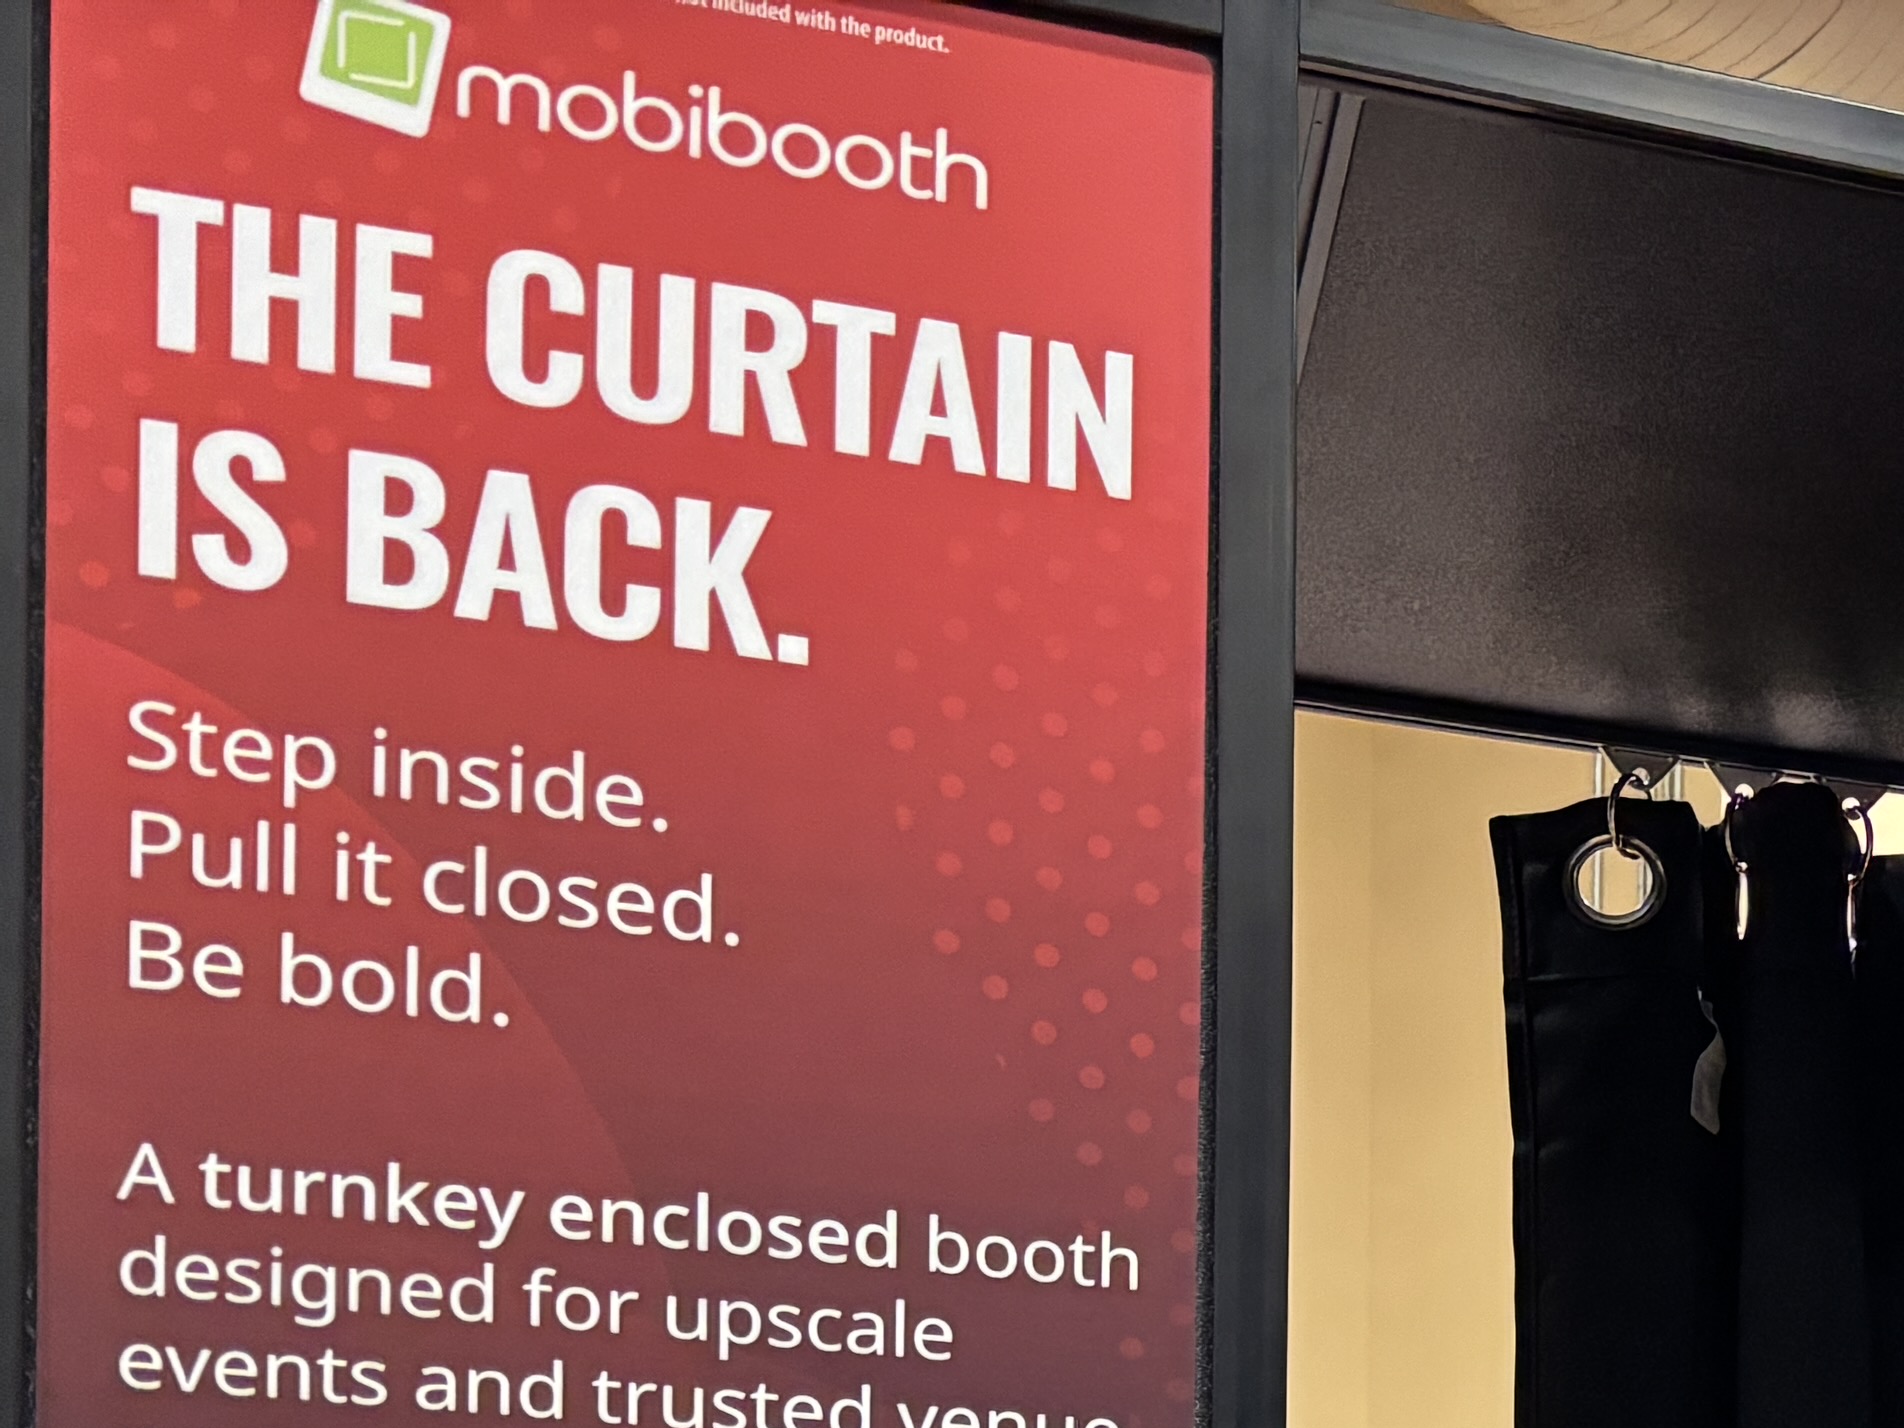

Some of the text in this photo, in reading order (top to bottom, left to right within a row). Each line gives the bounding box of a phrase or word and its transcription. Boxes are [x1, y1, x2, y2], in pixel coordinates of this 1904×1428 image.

[795, 8, 837, 32] with
[841, 16, 871, 38] the
[875, 25, 950, 53] product.
[457, 64, 988, 209] mobibooth
[130, 186, 1134, 501] THE CURTAIN
[136, 417, 810, 666] IS BACK.
[126, 699, 669, 833] Step inside.
[129, 807, 742, 947] Pull it closed.
[127, 920, 509, 1028] Be bold.
[117, 1143, 1140, 1292] A turnkey enclosed booth
[119, 1237, 954, 1361] designed for upscale
[119, 1336, 388, 1406] events
[415, 1359, 564, 1420] and
